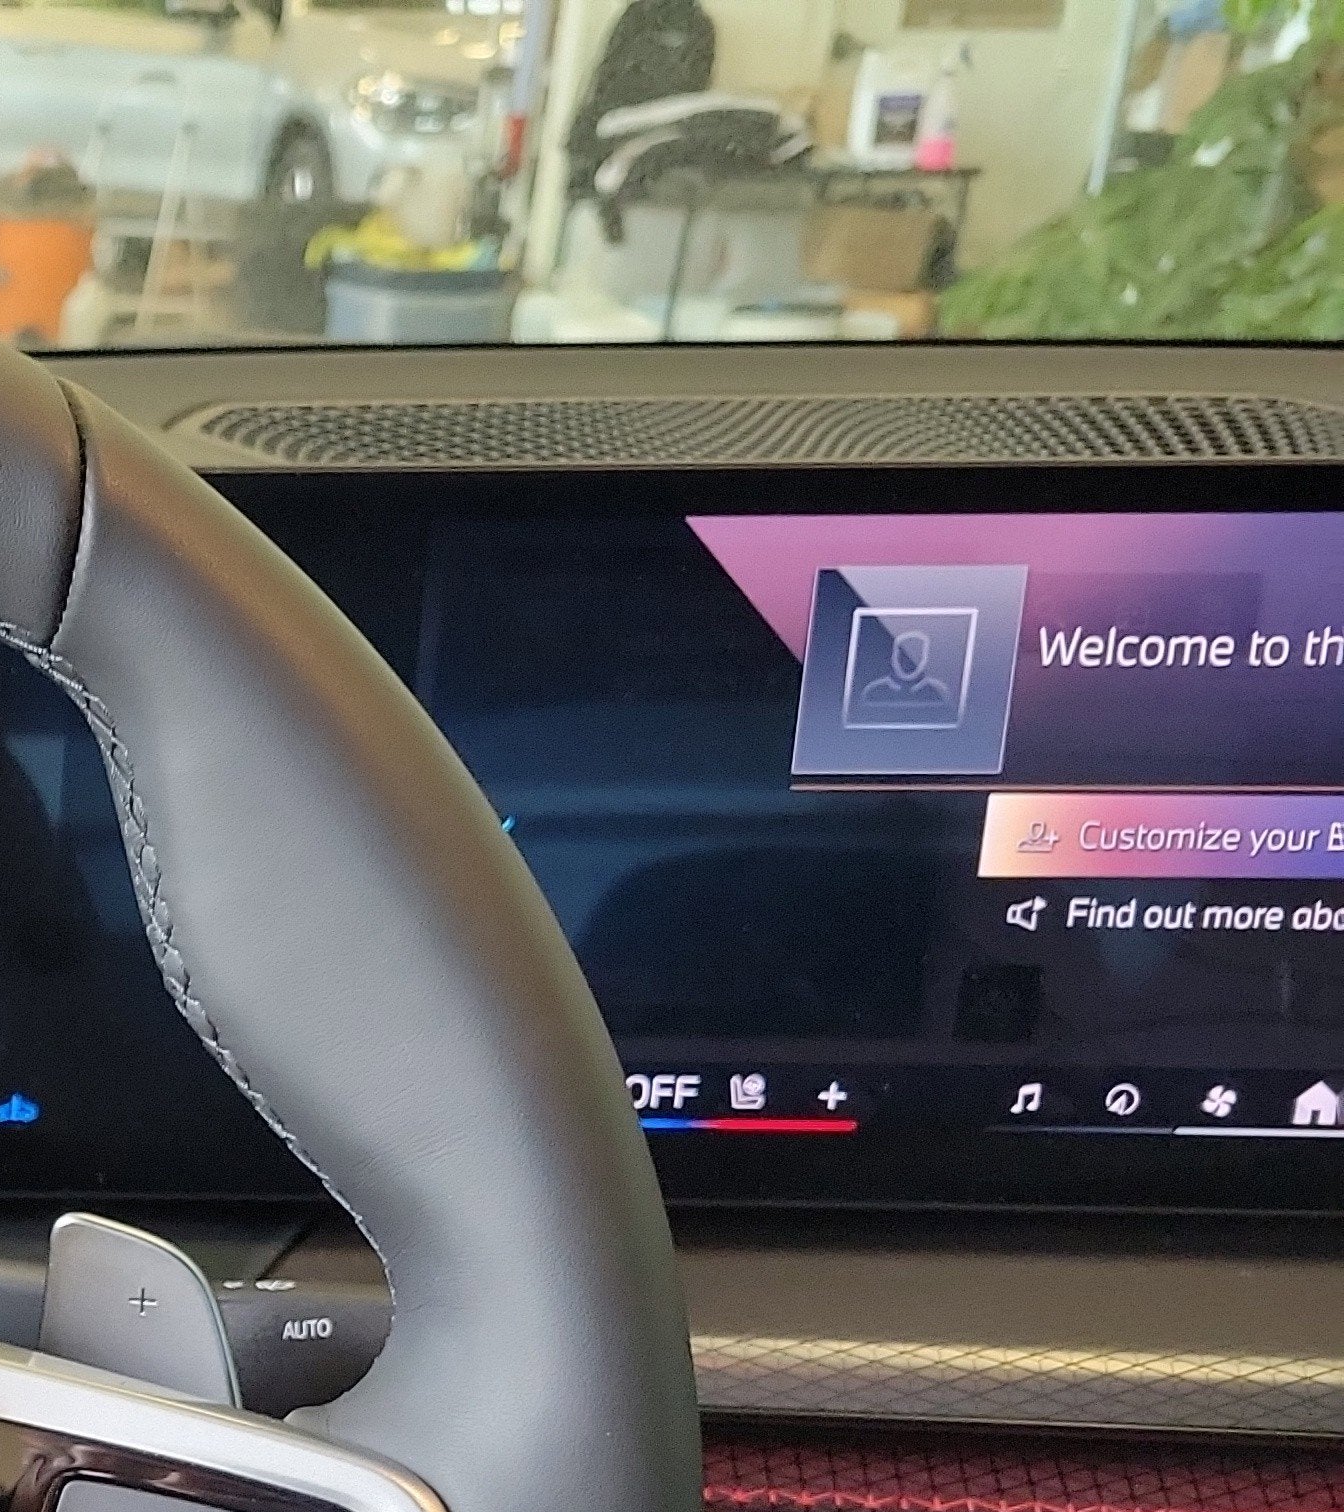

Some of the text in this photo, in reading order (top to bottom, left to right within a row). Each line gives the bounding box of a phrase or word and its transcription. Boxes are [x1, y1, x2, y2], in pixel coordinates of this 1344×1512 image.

[1039, 626, 1344, 667] Welcome to th
[1079, 820, 1240, 851] Customize
[1250, 829, 1320, 857] your
[1066, 897, 1136, 928] Find
[1144, 902, 1196, 928] out
[1202, 905, 1284, 930] more
[282, 1317, 332, 1341] AUTO
